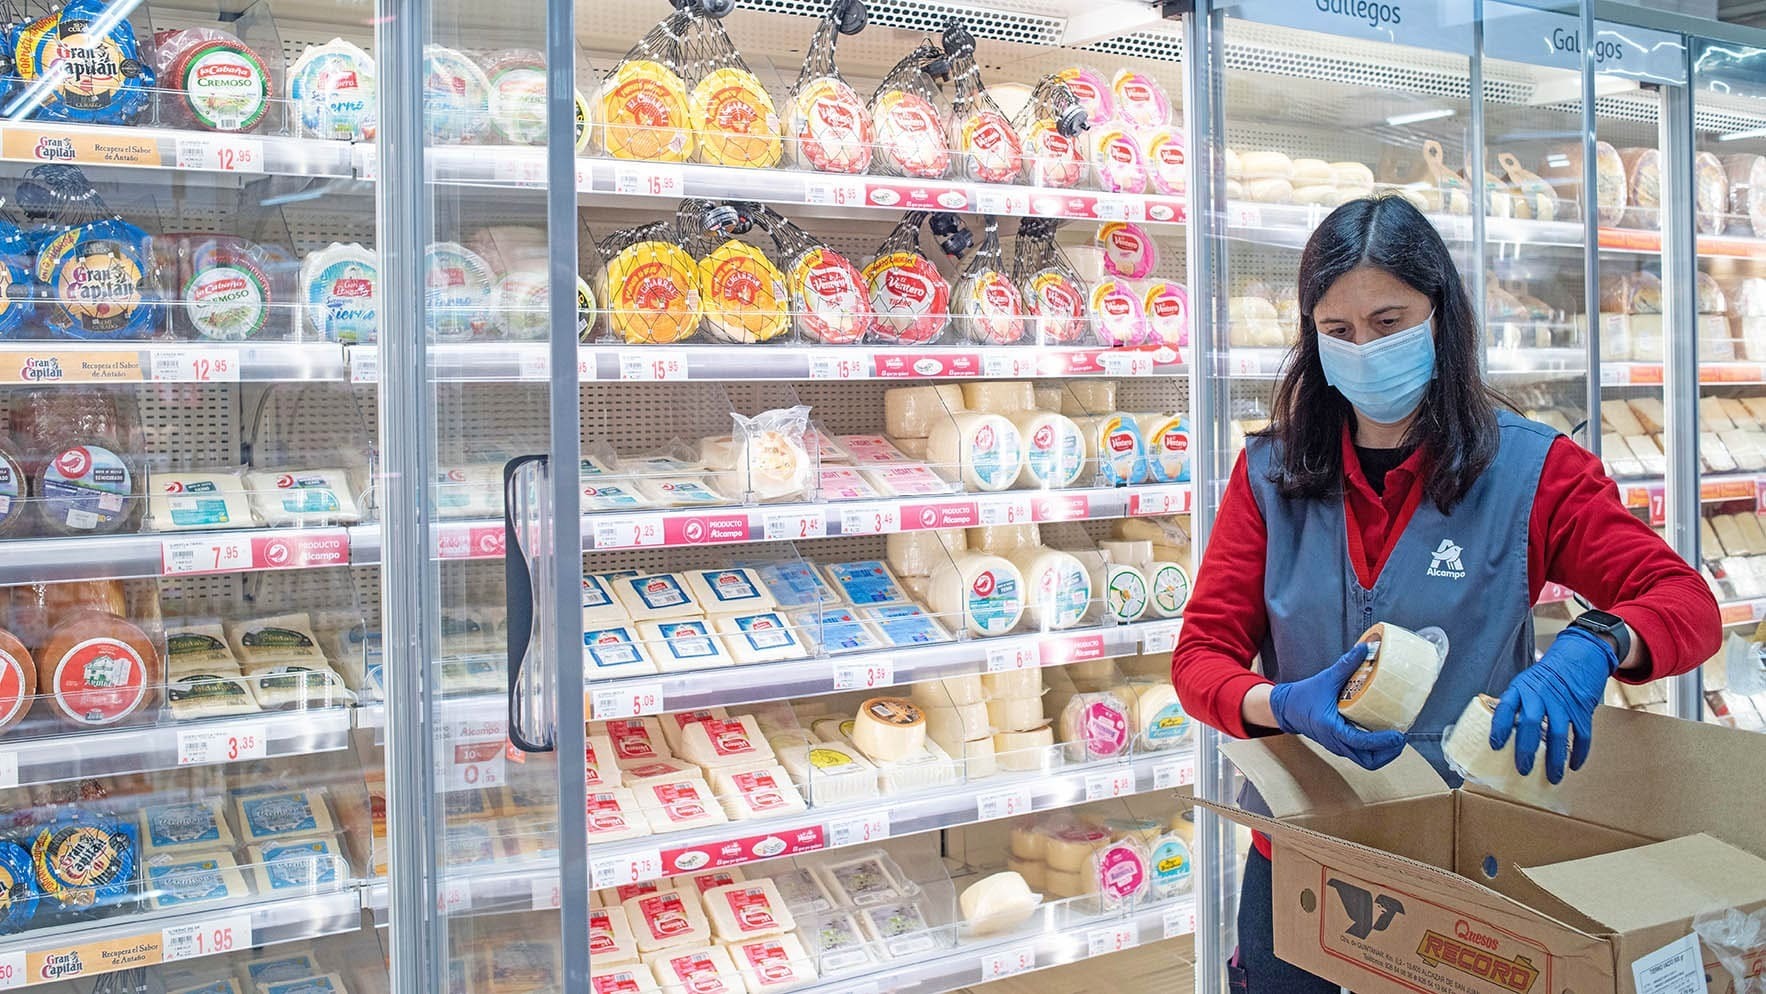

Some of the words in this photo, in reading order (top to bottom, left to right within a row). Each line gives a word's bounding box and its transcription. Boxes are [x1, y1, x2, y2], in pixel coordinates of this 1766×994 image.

[1553, 27, 1623, 63] Galgos
[198, 78, 252, 88] CREMOSO
[39, 136, 63, 147] Gran
[35, 143, 76, 161] Capitán
[73, 266, 111, 283] Gran
[888, 276, 925, 297] Ventero
[26, 356, 50, 368] Gran
[21, 365, 63, 381] Capitán
[709, 520, 743, 529] PRODUCTO
[212, 546, 239, 569] 7.95
[1426, 567, 1466, 580] Alcampo
[633, 695, 654, 715] 5.09
[228, 736, 255, 761] 3.35
[196, 927, 234, 955] 1.95
[1454, 919, 1500, 951] Quesos
[46, 954, 70, 965] Gran
[101, 947, 132, 959] Recupera
[139, 943, 159, 952] Sabor
[111, 957, 121, 965] de
[1424, 934, 1533, 991] RECORD
[41, 962, 83, 979] Capitán
